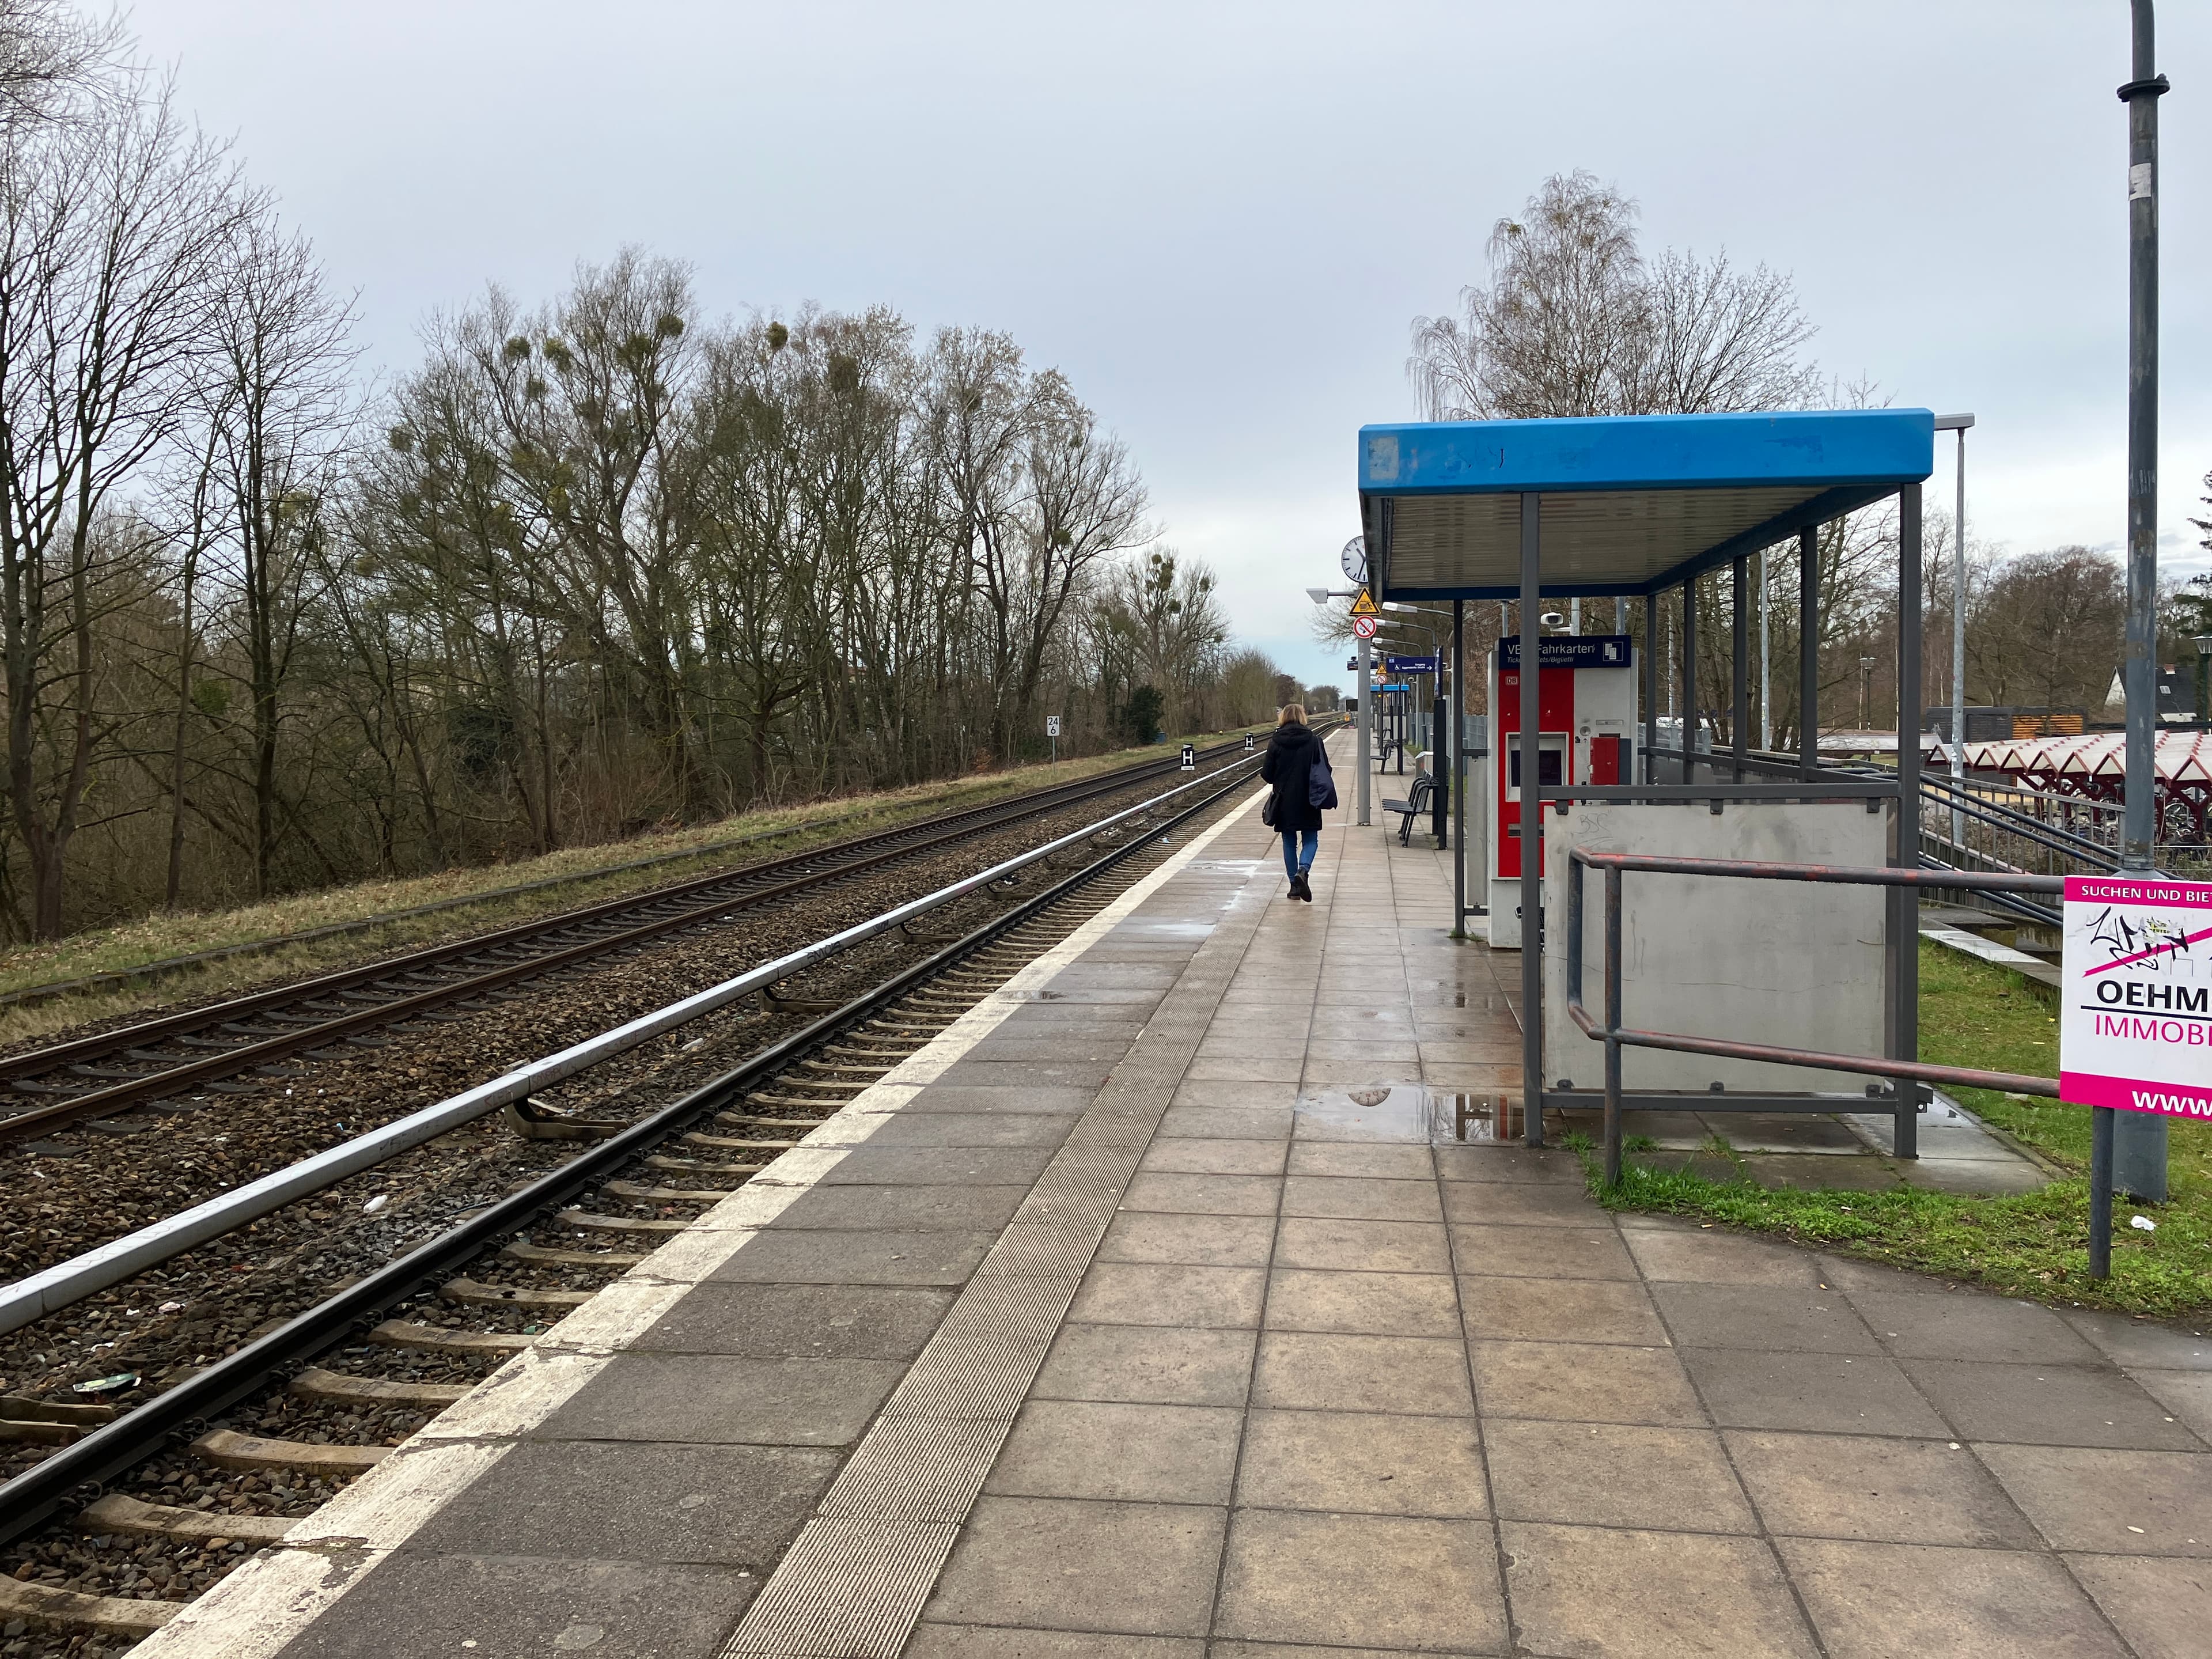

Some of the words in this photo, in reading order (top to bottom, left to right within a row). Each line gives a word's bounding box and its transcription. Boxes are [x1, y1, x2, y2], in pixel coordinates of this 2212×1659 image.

[1539, 643, 1594, 654] Fahrkarten
[1048, 717, 1058, 726] 24
[1050, 726, 1056, 734] 6
[1245, 737, 1253, 747] H
[1183, 751, 1193, 765] H
[2081, 885, 2141, 899] SUCHEN
[2146, 889, 2181, 901] UND
[2186, 891, 2212, 903] BIE
[2096, 980, 2212, 1013] OEHM
